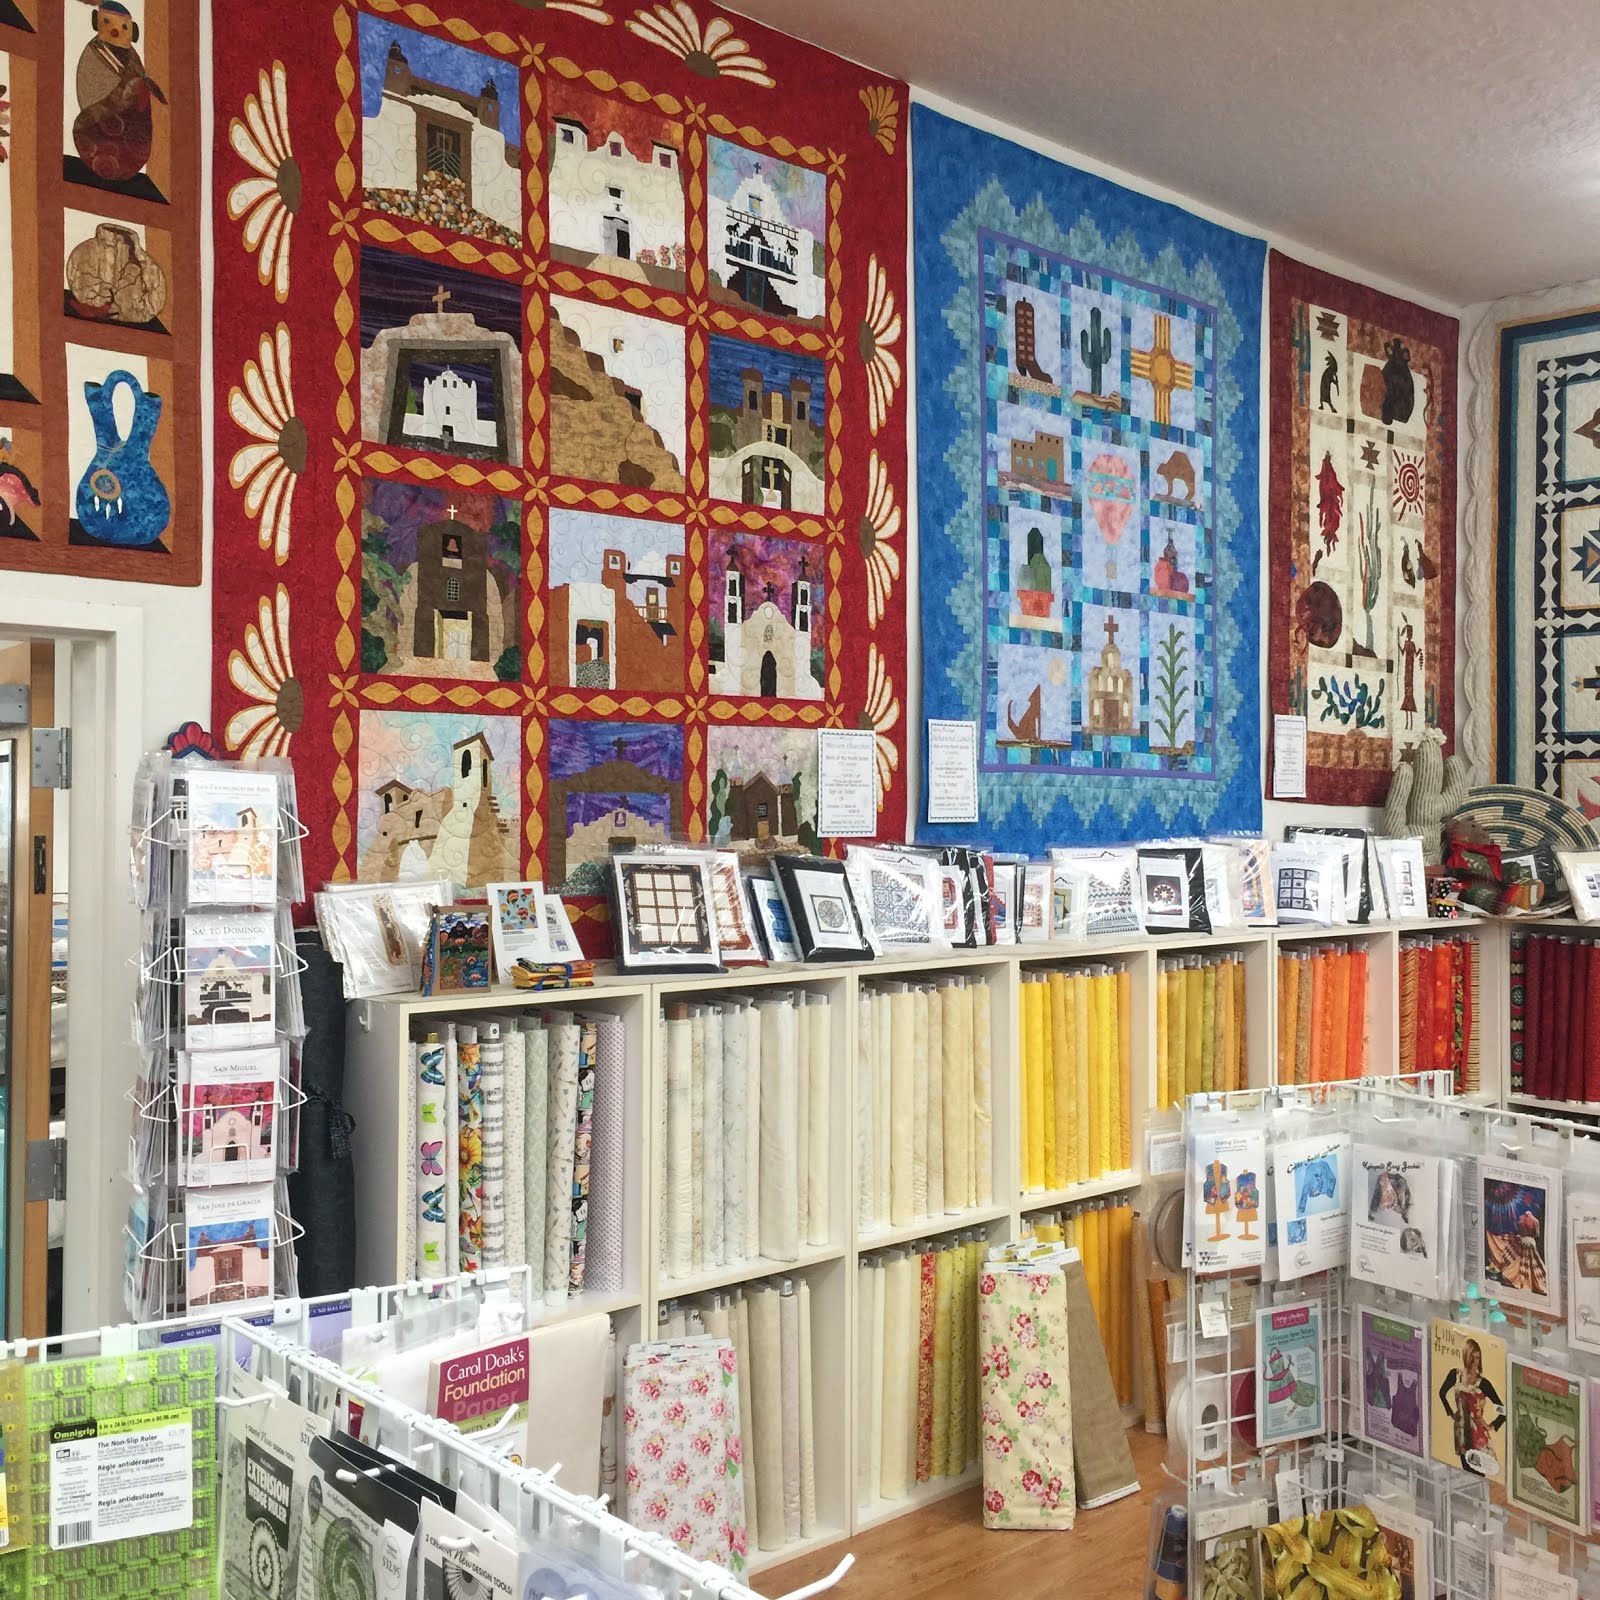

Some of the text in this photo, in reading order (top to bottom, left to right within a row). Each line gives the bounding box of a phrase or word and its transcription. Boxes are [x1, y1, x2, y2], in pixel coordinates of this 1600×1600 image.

[223, 926, 267, 936] DOMINGO
[213, 1064, 258, 1073] SAN MIGUEL
[236, 1199, 262, 1207] GRACIA
[195, 1327, 212, 1335] MATH
[1434, 1324, 1456, 1346] Lilly
[446, 1346, 525, 1382] Carol Doak's
[444, 1367, 526, 1403] Foundation
[452, 1390, 519, 1422] Paper
[53, 1427, 96, 1441] Omnigrip
[97, 1434, 158, 1449] The Non-Slip Ruler
[97, 1463, 117, 1472] Règle
[117, 1456, 165, 1469] antidérapante
[247, 1456, 290, 1508] EXTENSION
[97, 1498, 117, 1507] Regla
[117, 1491, 164, 1503] antideslizante
[247, 1479, 288, 1525] WEDGE RULER
[382, 1555, 400, 1579] $32.95
[453, 1549, 473, 1569] New
[472, 1563, 493, 1583] DESIGN
[493, 1576, 513, 1596] TOOLS!
